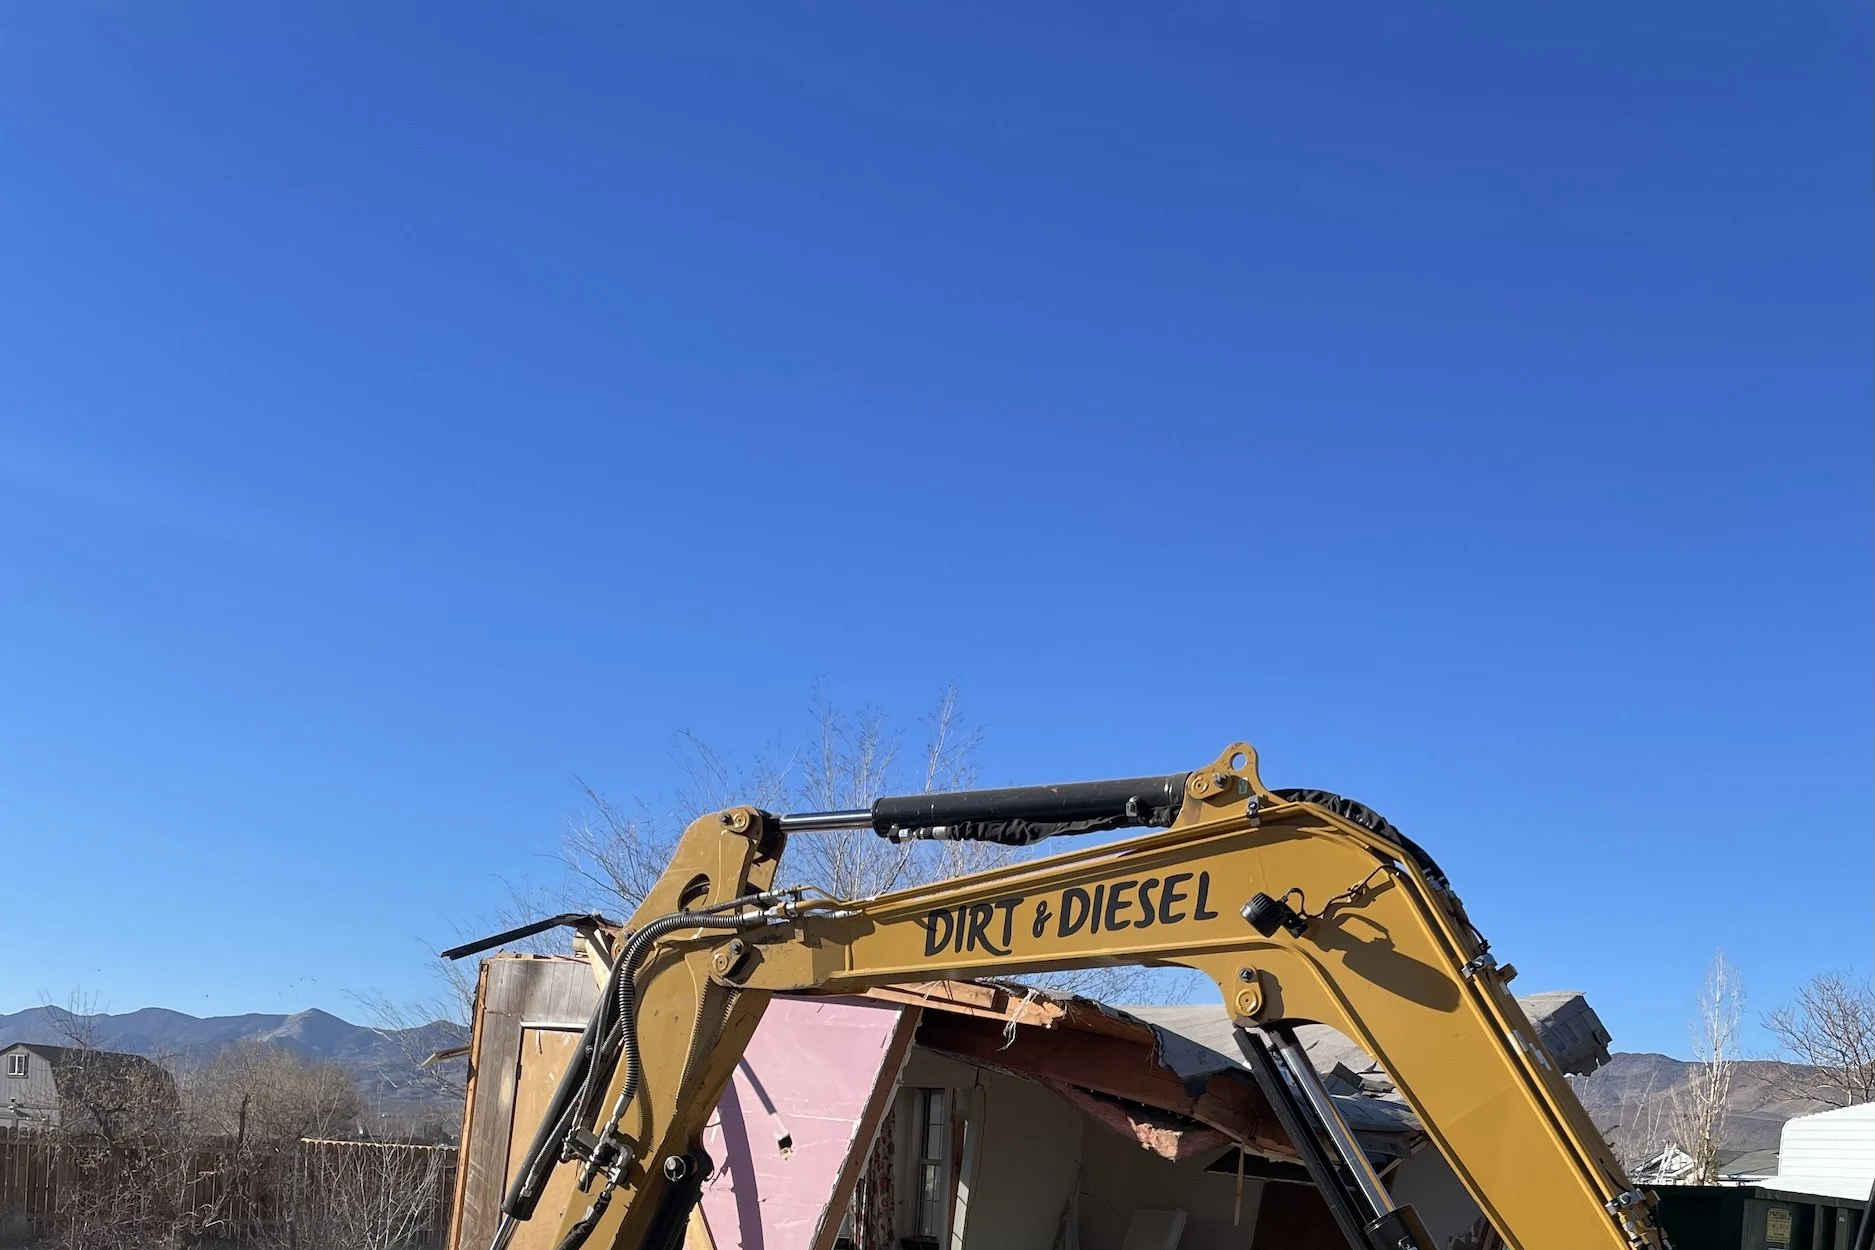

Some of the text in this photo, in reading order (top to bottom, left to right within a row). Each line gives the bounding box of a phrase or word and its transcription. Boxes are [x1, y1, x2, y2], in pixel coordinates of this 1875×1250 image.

[925, 871, 1218, 956] DIRT & DIESEL
